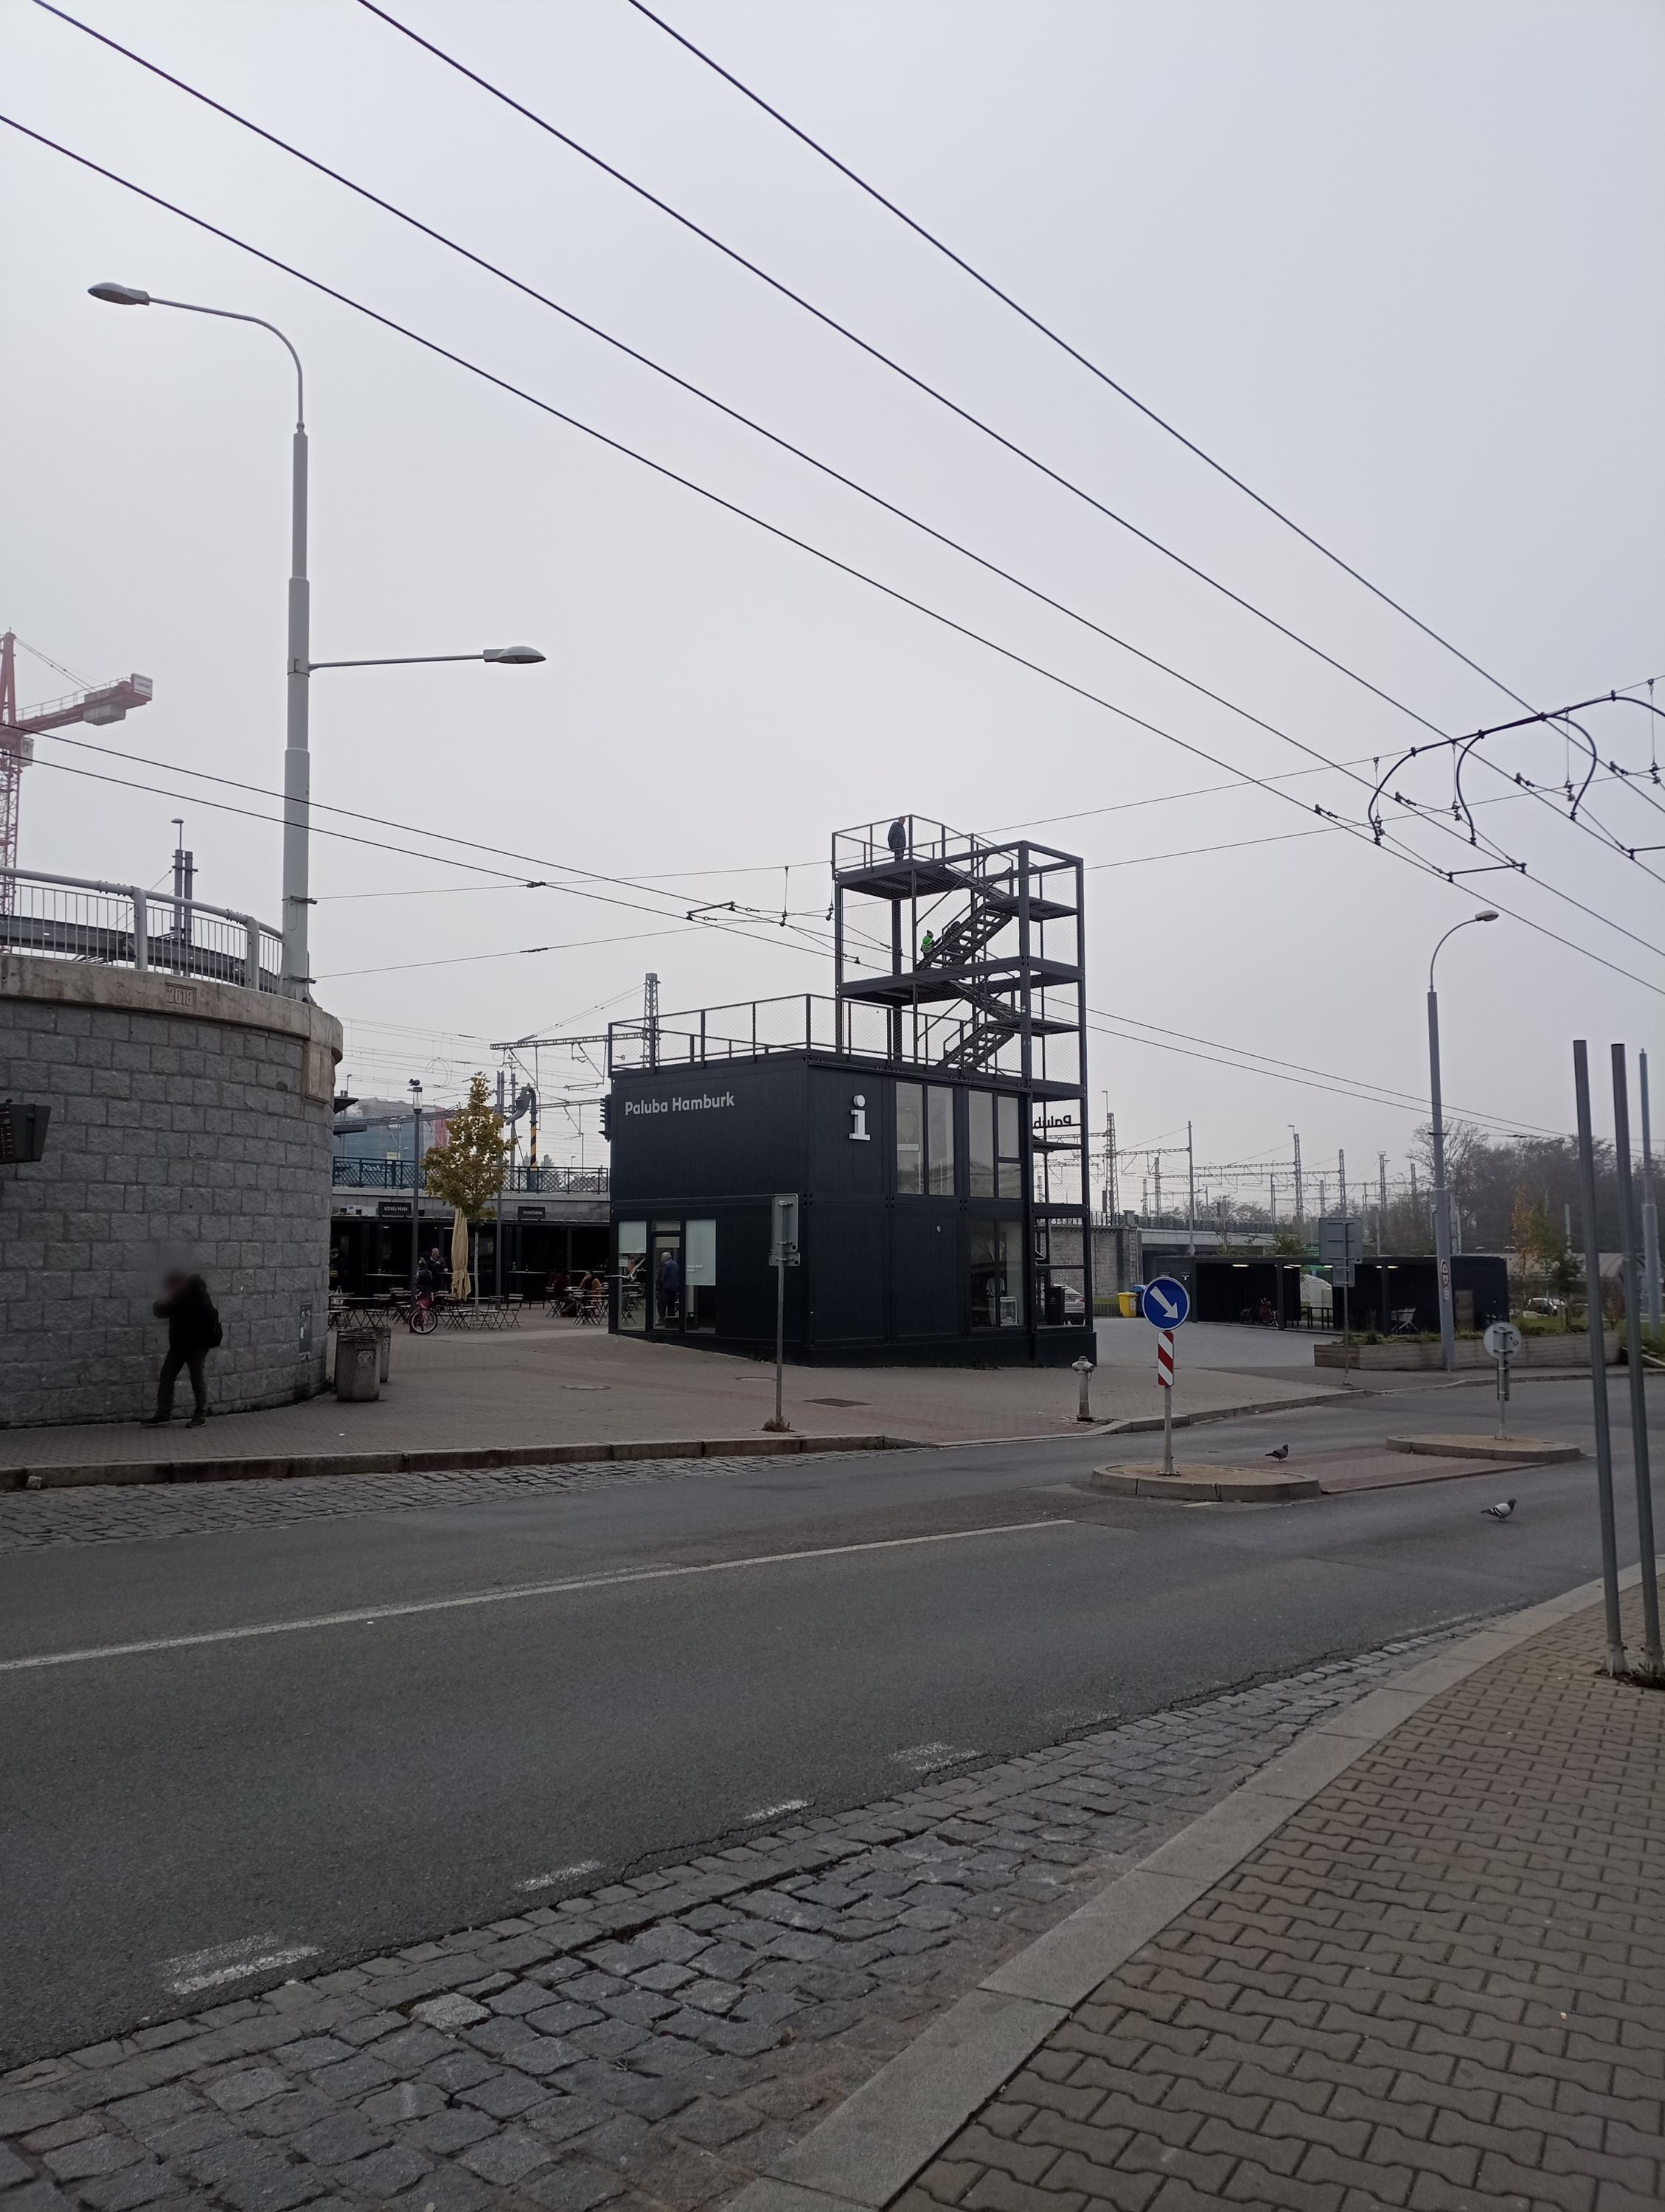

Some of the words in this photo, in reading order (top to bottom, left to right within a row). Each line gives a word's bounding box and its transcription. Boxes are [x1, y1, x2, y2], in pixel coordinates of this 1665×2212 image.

[167, 987, 192, 1006] 2018
[625, 1099, 668, 1116] Paluba
[672, 1091, 735, 1112] Hamburk
[849, 1095, 871, 1141] i
